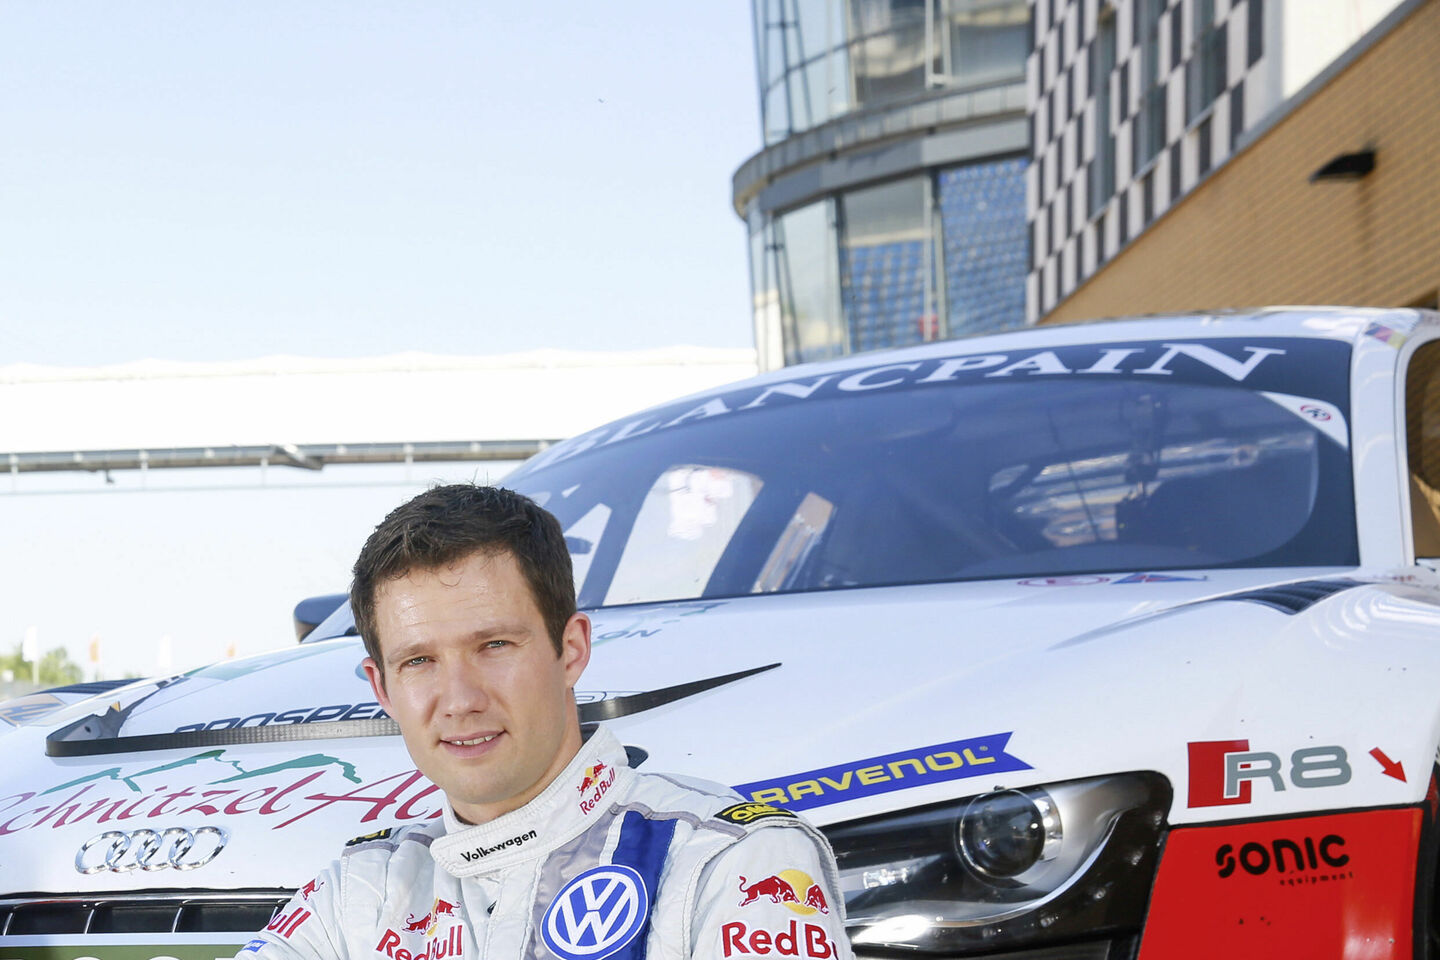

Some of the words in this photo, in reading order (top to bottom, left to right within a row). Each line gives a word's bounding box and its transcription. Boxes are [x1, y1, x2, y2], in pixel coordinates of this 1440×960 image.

[526, 345, 1287, 474] BLANCPAIN
[579, 791, 602, 816] Red
[599, 767, 616, 797] Bull
[751, 747, 996, 805] RAVENOL
[460, 829, 538, 862] Volkswagen
[1278, 871, 1354, 888] equipment
[266, 906, 311, 939] ull
[721, 920, 800, 959] Red
